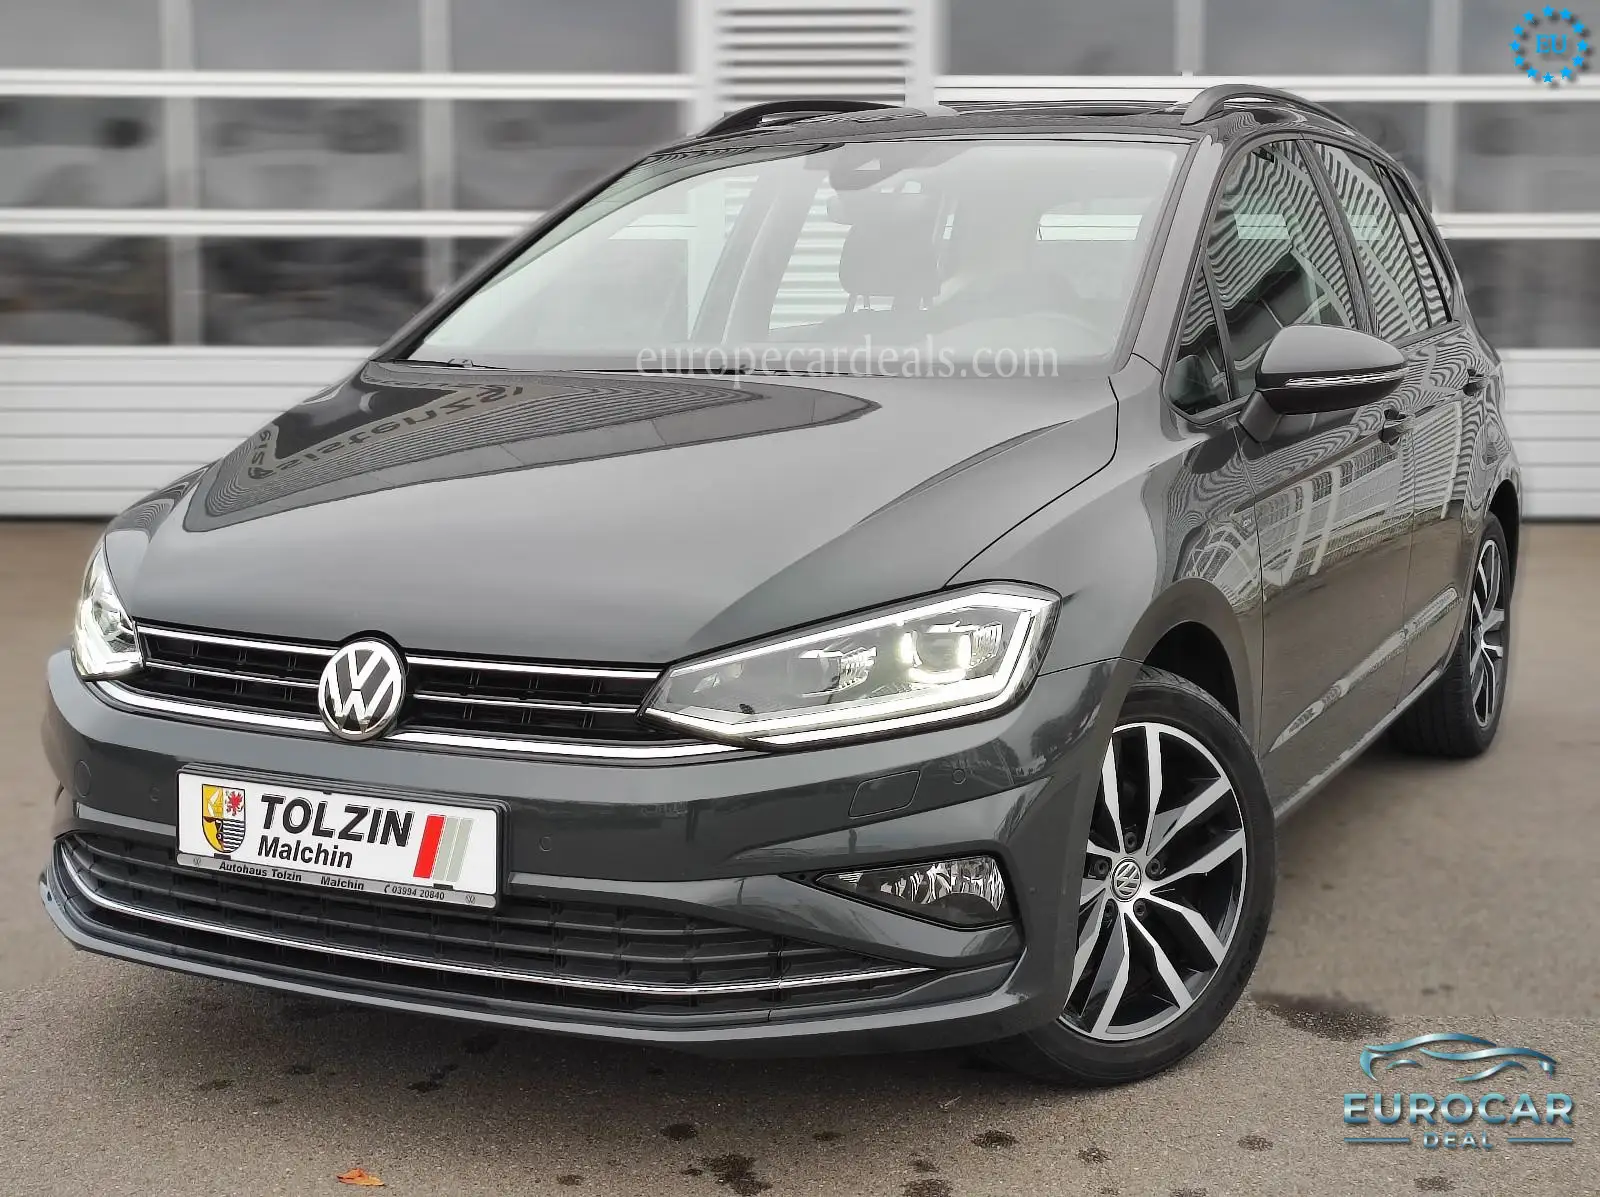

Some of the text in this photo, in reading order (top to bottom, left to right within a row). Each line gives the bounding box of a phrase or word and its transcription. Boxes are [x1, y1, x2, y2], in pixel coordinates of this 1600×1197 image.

[319, 638, 404, 738] VW
[260, 794, 414, 848] TOLZIN
[257, 834, 353, 869] Malchin
[219, 860, 302, 882] Autohaus Tolzin
[320, 875, 365, 891] Malchin
[419, 889, 445, 900] 20840
